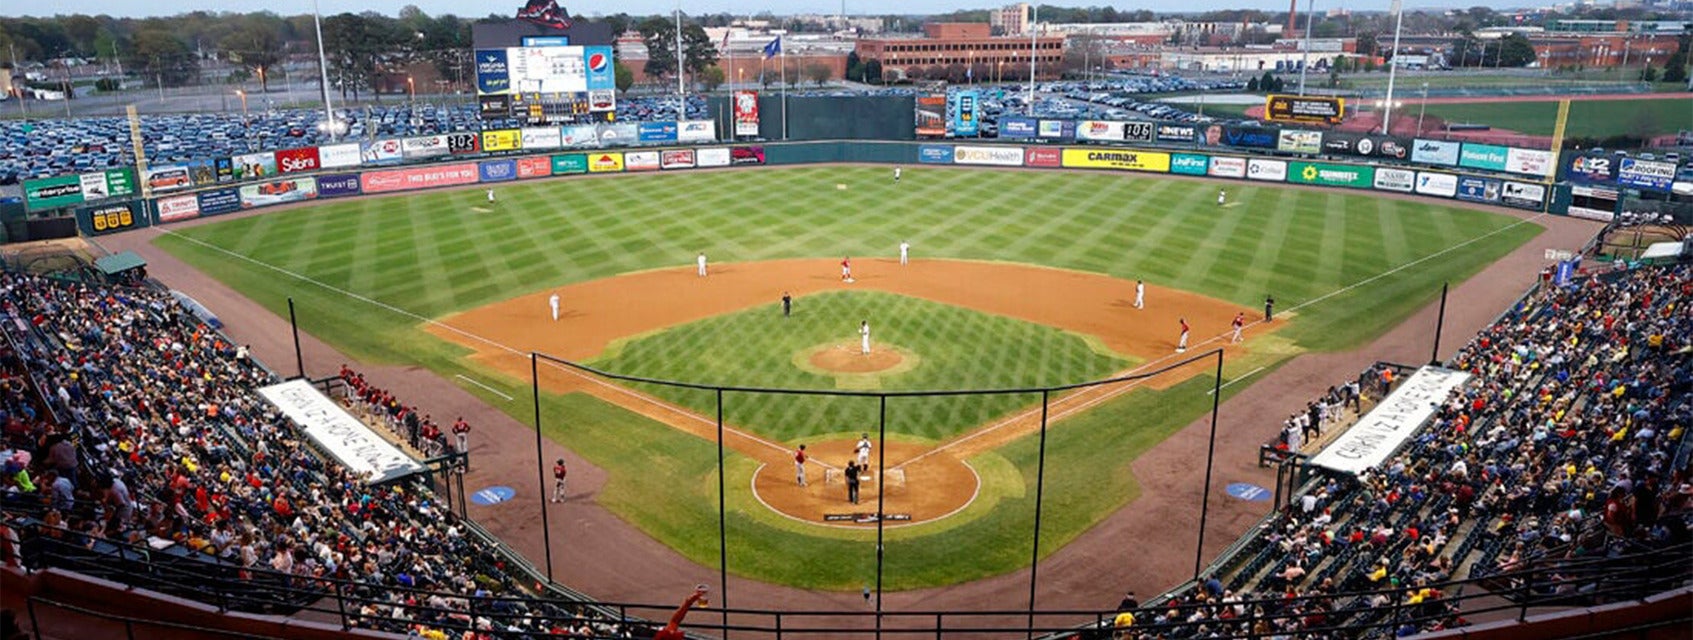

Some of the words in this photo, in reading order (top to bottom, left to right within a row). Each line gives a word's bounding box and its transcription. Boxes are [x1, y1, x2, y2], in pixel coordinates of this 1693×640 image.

[1127, 124, 1150, 137] 106
[448, 134, 475, 149] 302
[281, 156, 315, 172] Sabra
[1634, 164, 1674, 177] ROOFING
[31, 184, 81, 199] enterprise
